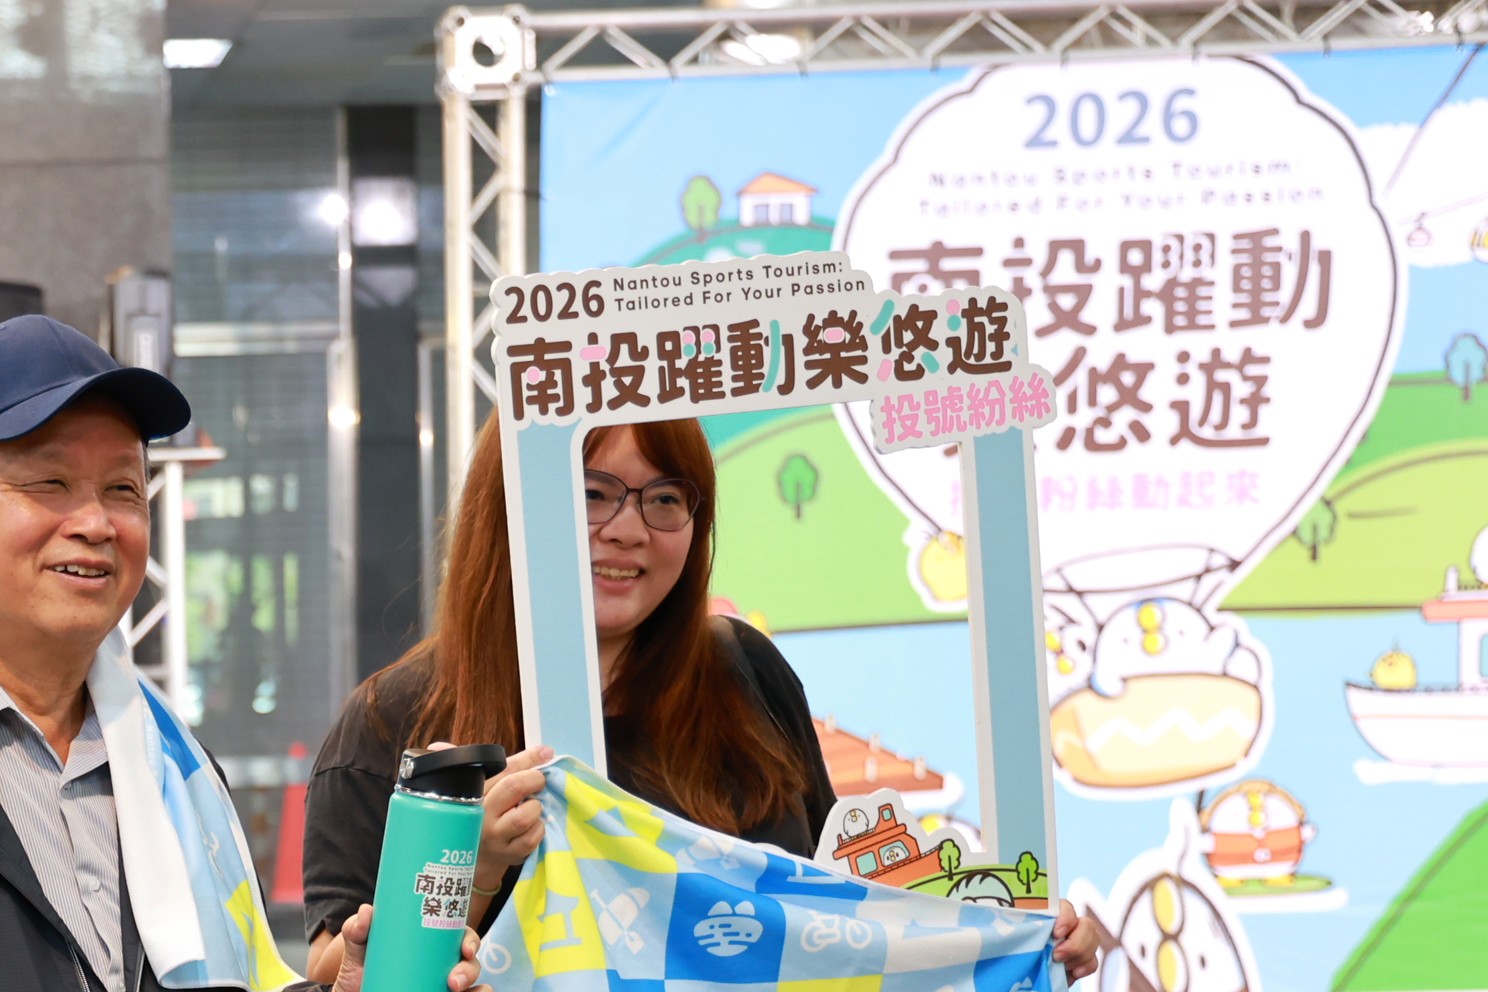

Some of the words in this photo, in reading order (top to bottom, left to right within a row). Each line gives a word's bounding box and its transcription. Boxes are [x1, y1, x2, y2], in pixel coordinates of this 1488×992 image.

[1023, 88, 1199, 149] 2026
[613, 274, 682, 292] Nantou
[690, 268, 754, 288] Sports
[762, 260, 844, 280] Tourism:
[614, 292, 694, 312] Tailored
[702, 290, 732, 305] For
[740, 284, 783, 301] Your
[791, 279, 866, 297] Passion
[503, 279, 605, 324] 2026
[506, 295, 1013, 422] 南投躍動樂悠遊
[880, 372, 1054, 445] 投號粉絲
[440, 849, 473, 864] 2026
